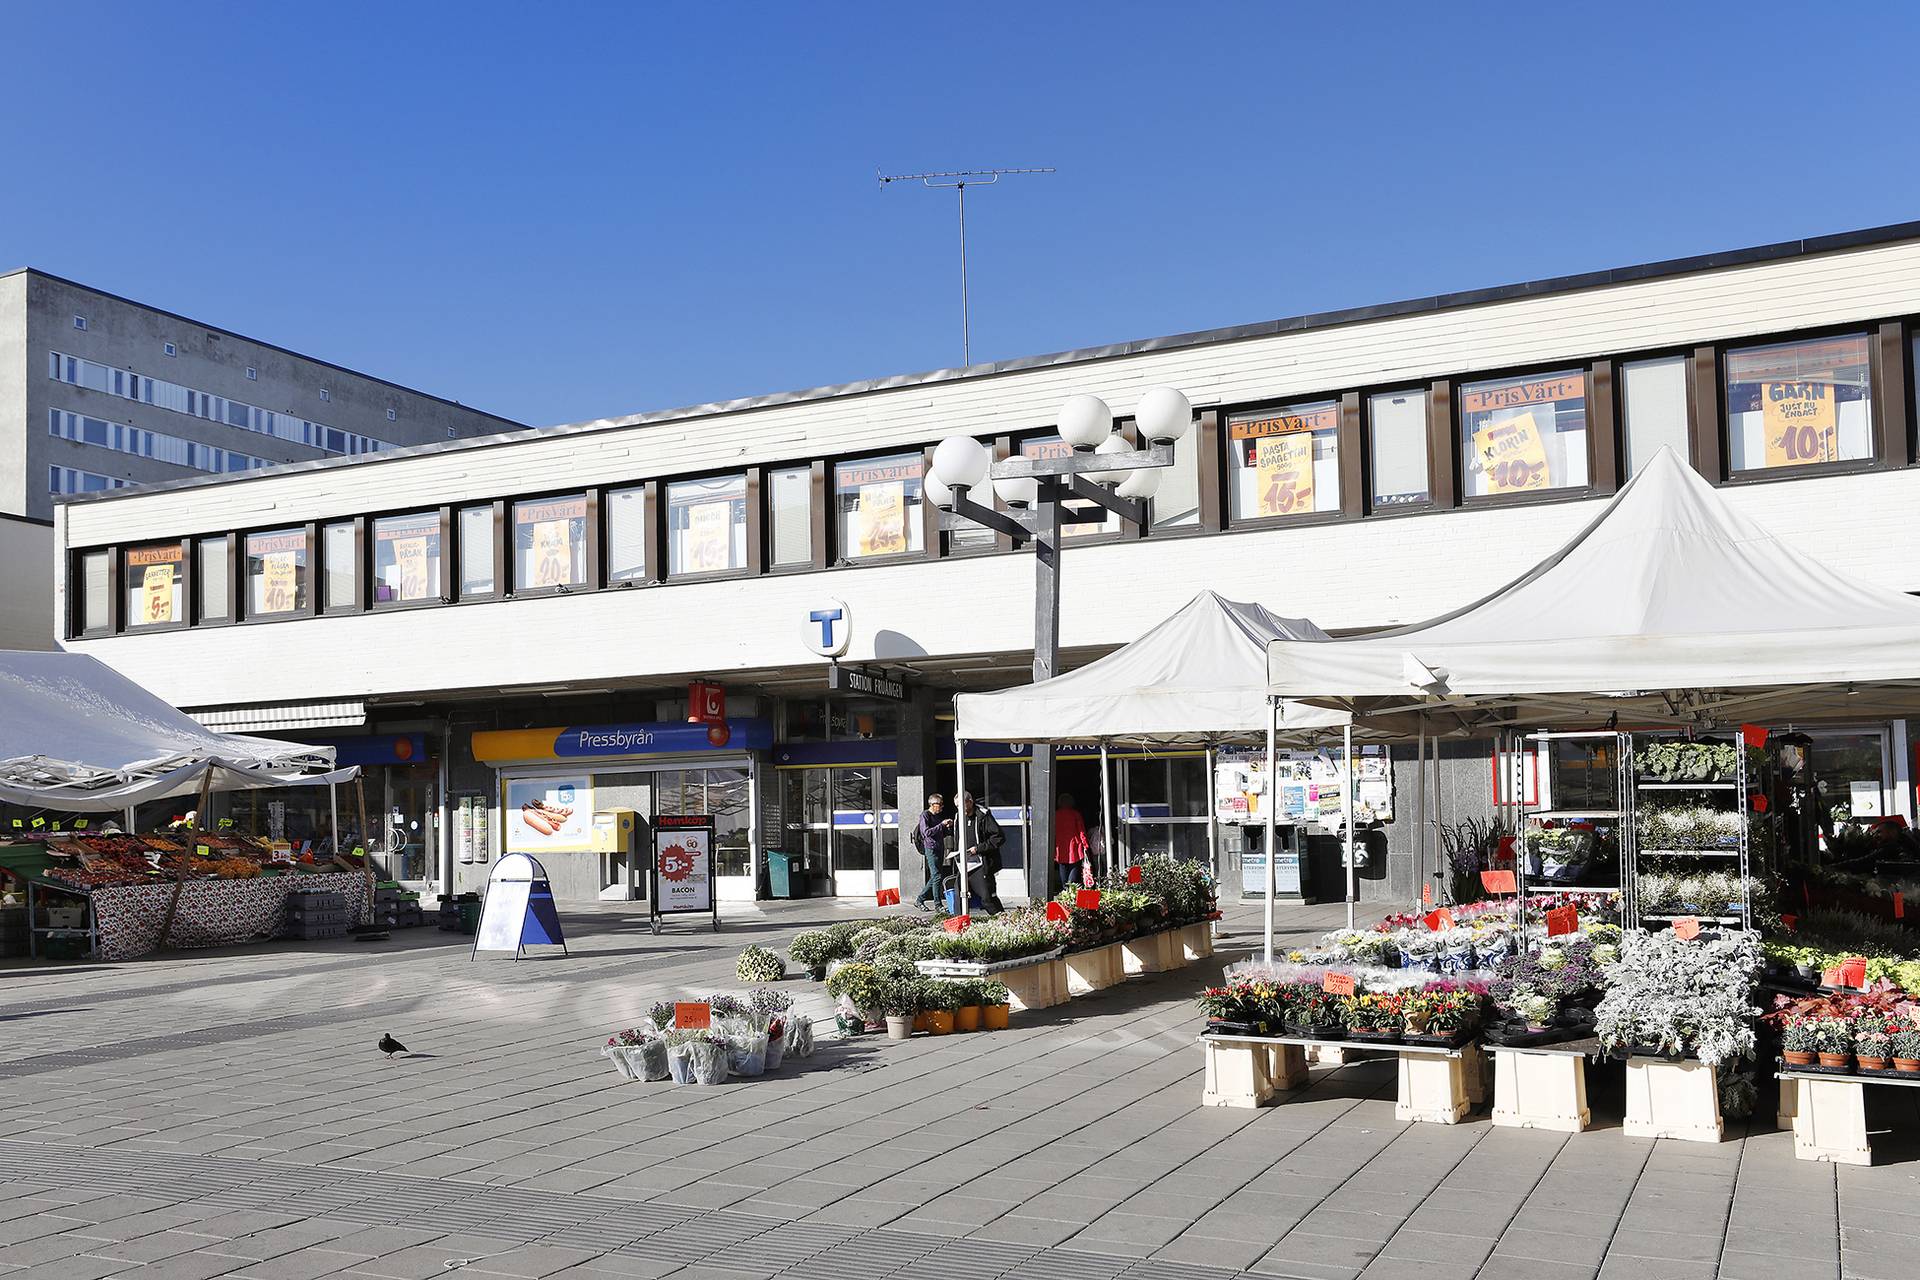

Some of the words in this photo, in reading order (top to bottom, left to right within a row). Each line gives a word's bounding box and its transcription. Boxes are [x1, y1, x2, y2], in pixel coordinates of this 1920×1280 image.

[1769, 383, 1825, 402] GARN
[1780, 402, 1802, 413] JUST
[1039, 444, 1068, 459] Pris
[1263, 441, 1289, 457] PASTA
[1484, 429, 1529, 461] KLORIN
[810, 608, 842, 648] T
[849, 672, 872, 693] STATION
[579, 728, 654, 750] Pressbyrån
[664, 856, 689, 873] 5:-
[672, 886, 695, 894] BACON
